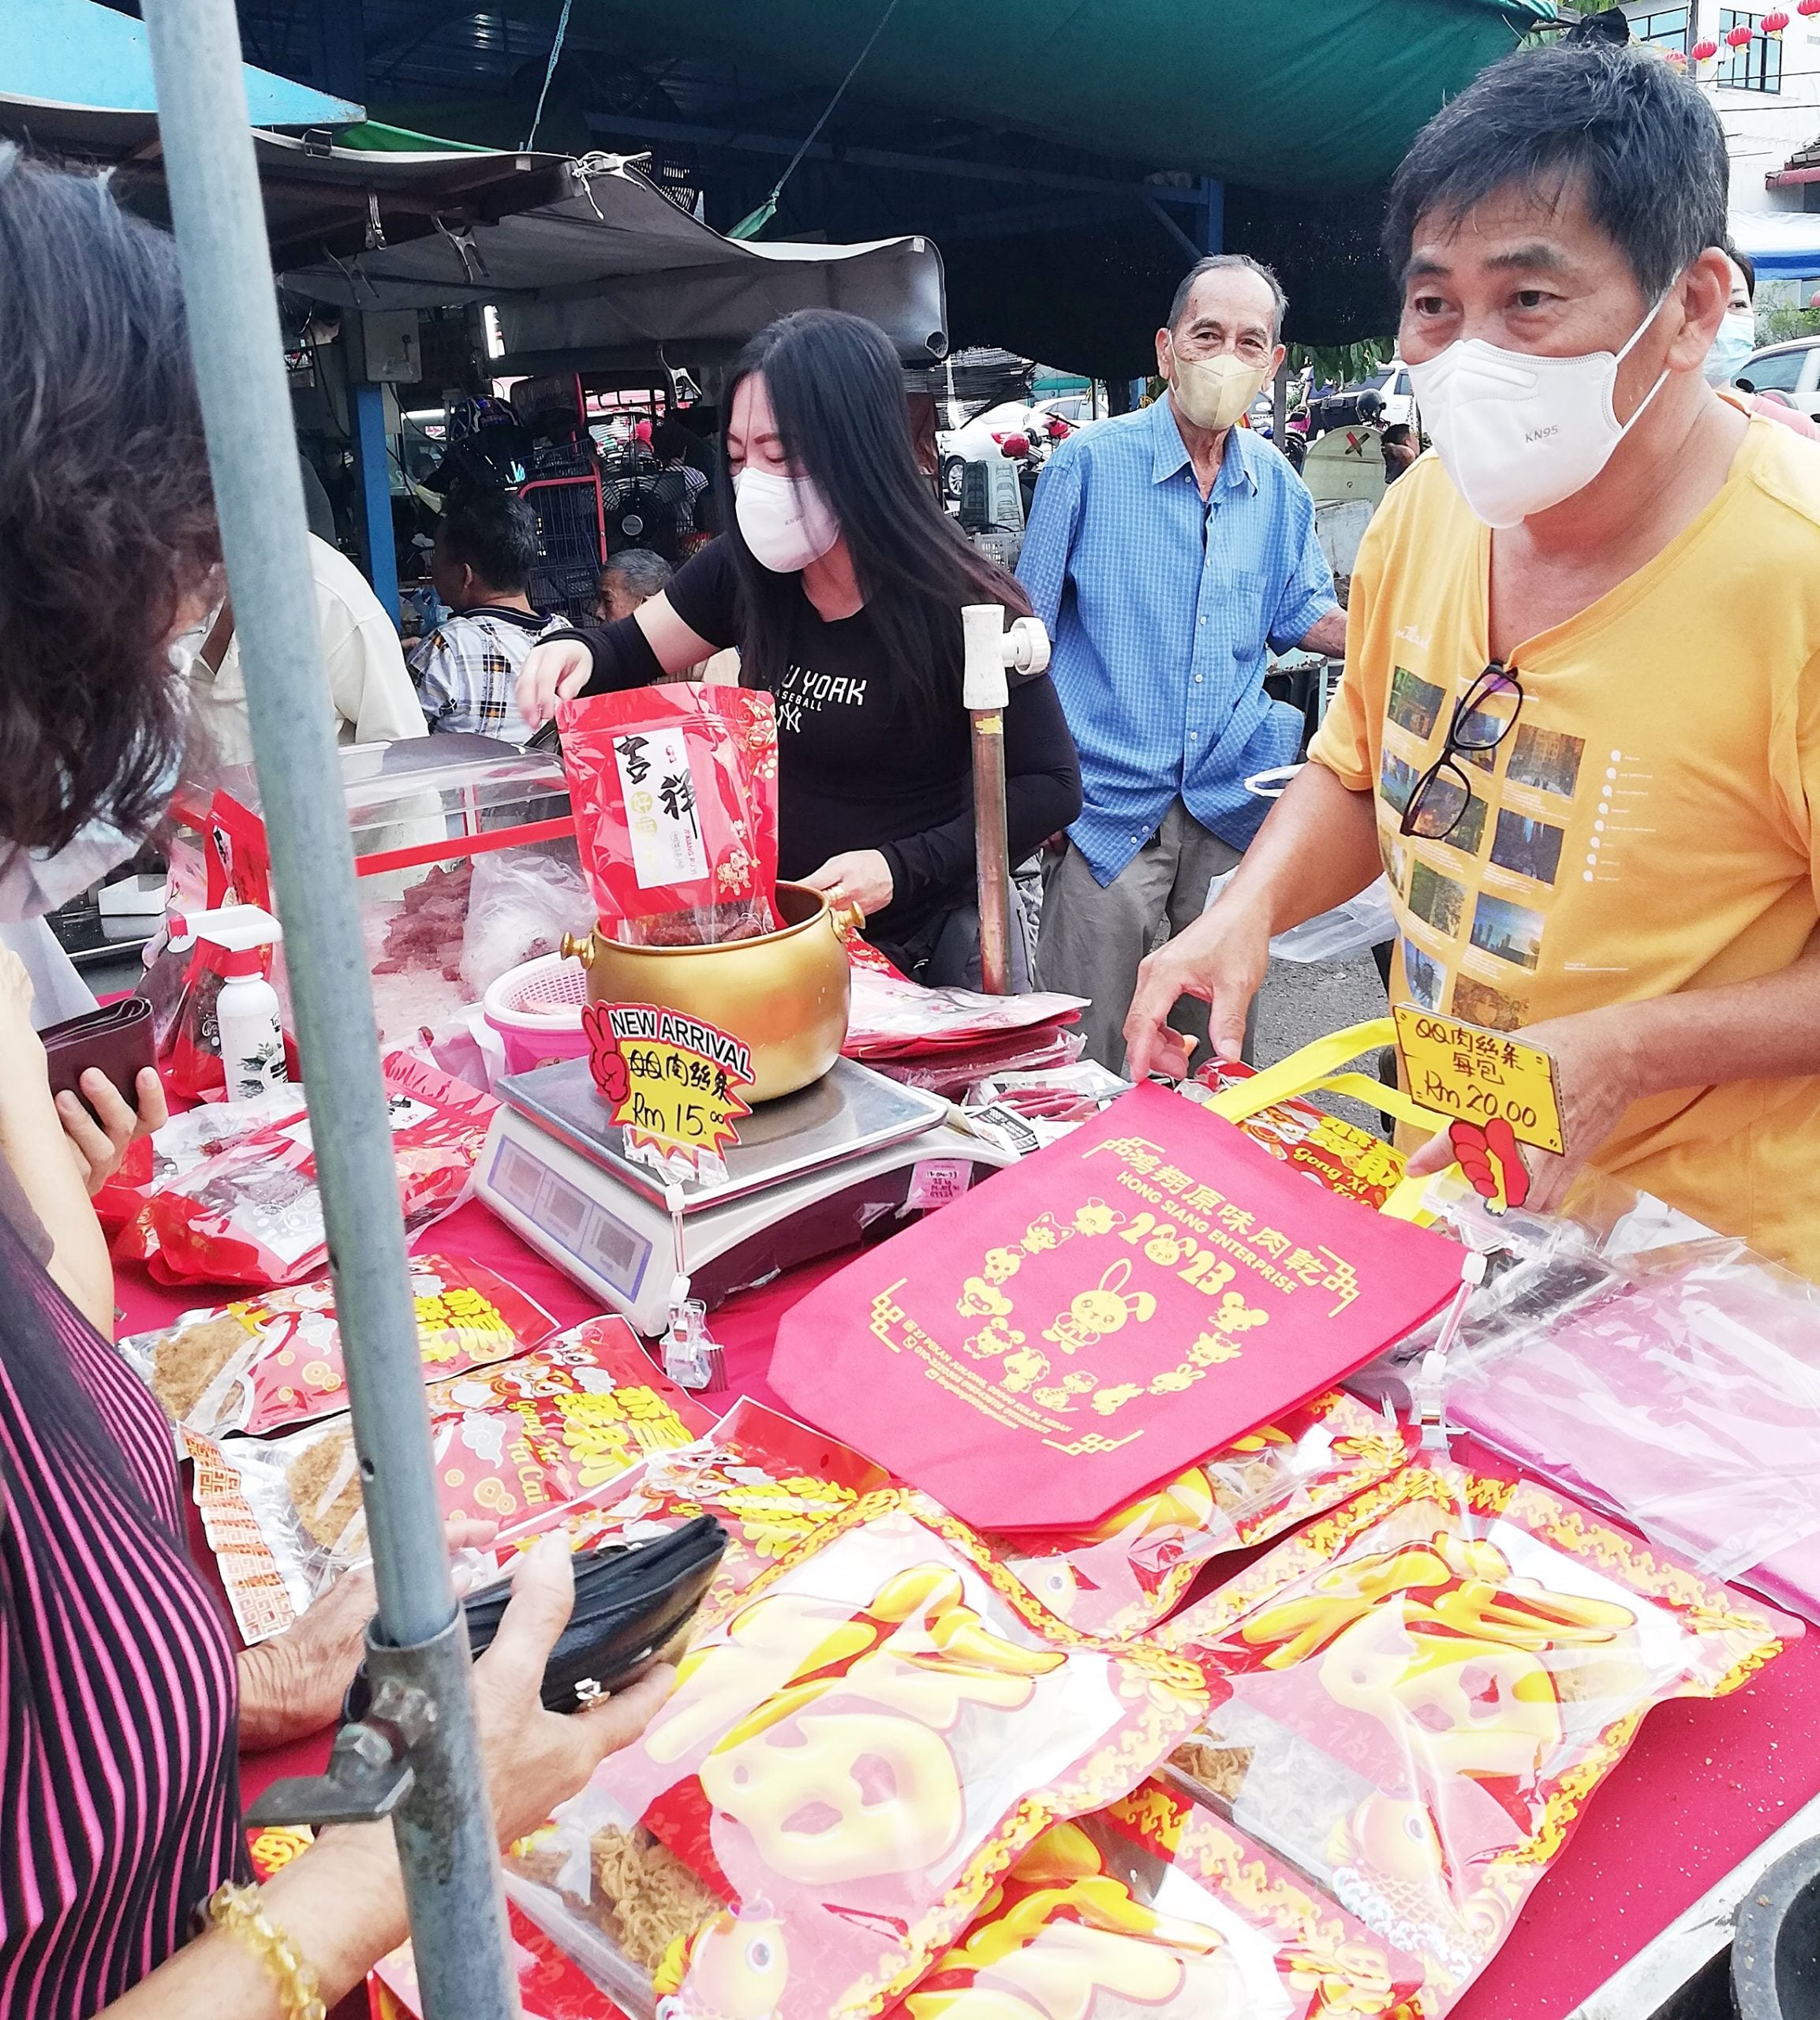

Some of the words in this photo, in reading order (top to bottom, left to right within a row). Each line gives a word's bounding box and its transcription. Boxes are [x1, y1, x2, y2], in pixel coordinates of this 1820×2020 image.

[1525, 425, 1558, 443] KN95
[802, 671, 867, 705] YORK
[611, 1012, 655, 1036] NEW
[661, 1016, 752, 1080] ARRIVAL
[1294, 1147, 1343, 1180] Gong
[1346, 1175, 1370, 1195] Xi
[1116, 1171, 1162, 1203] HONG
[1160, 1199, 1210, 1234] SIANG
[1208, 1228, 1299, 1295] ENTERPRISE
[507, 1400, 547, 1436] Gong
[506, 1437, 534, 1465] Fa
[518, 1465, 550, 1506] Cai
